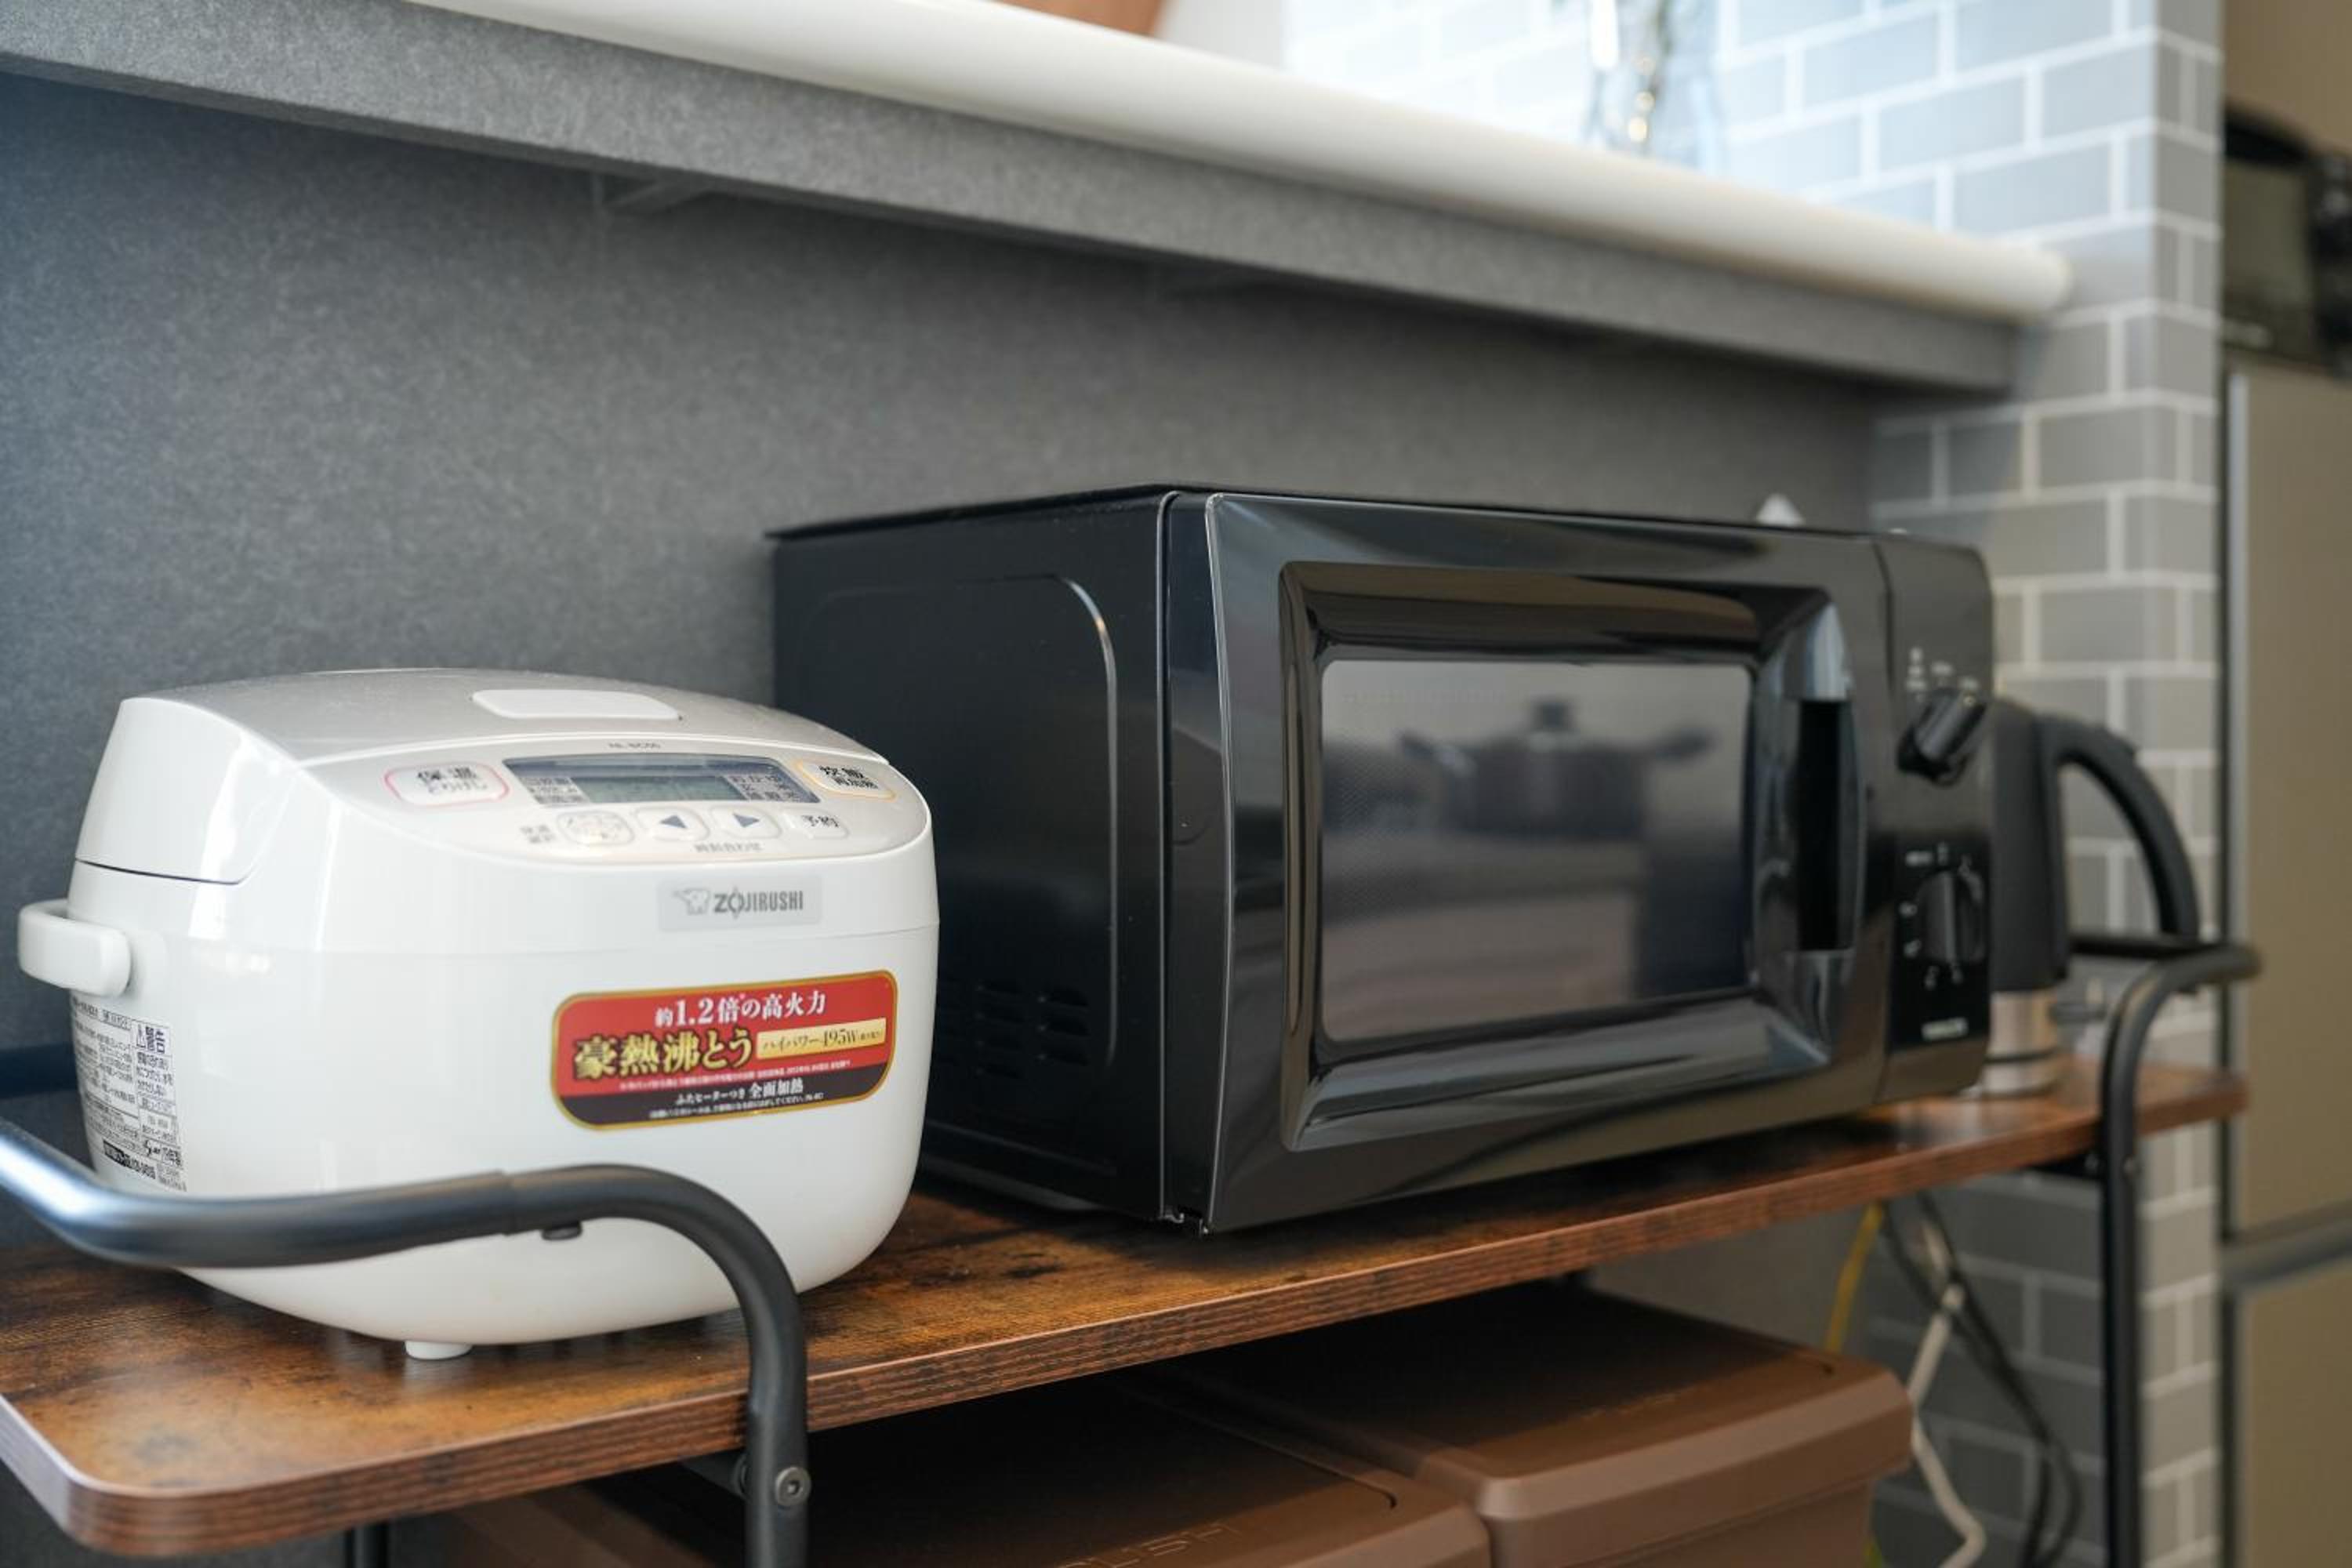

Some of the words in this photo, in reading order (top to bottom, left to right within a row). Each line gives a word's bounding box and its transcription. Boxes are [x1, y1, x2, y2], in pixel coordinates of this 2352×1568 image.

[713, 887, 803, 918] ZOJIRUSHI
[574, 1029, 753, 1078] 豪熱沸とう
